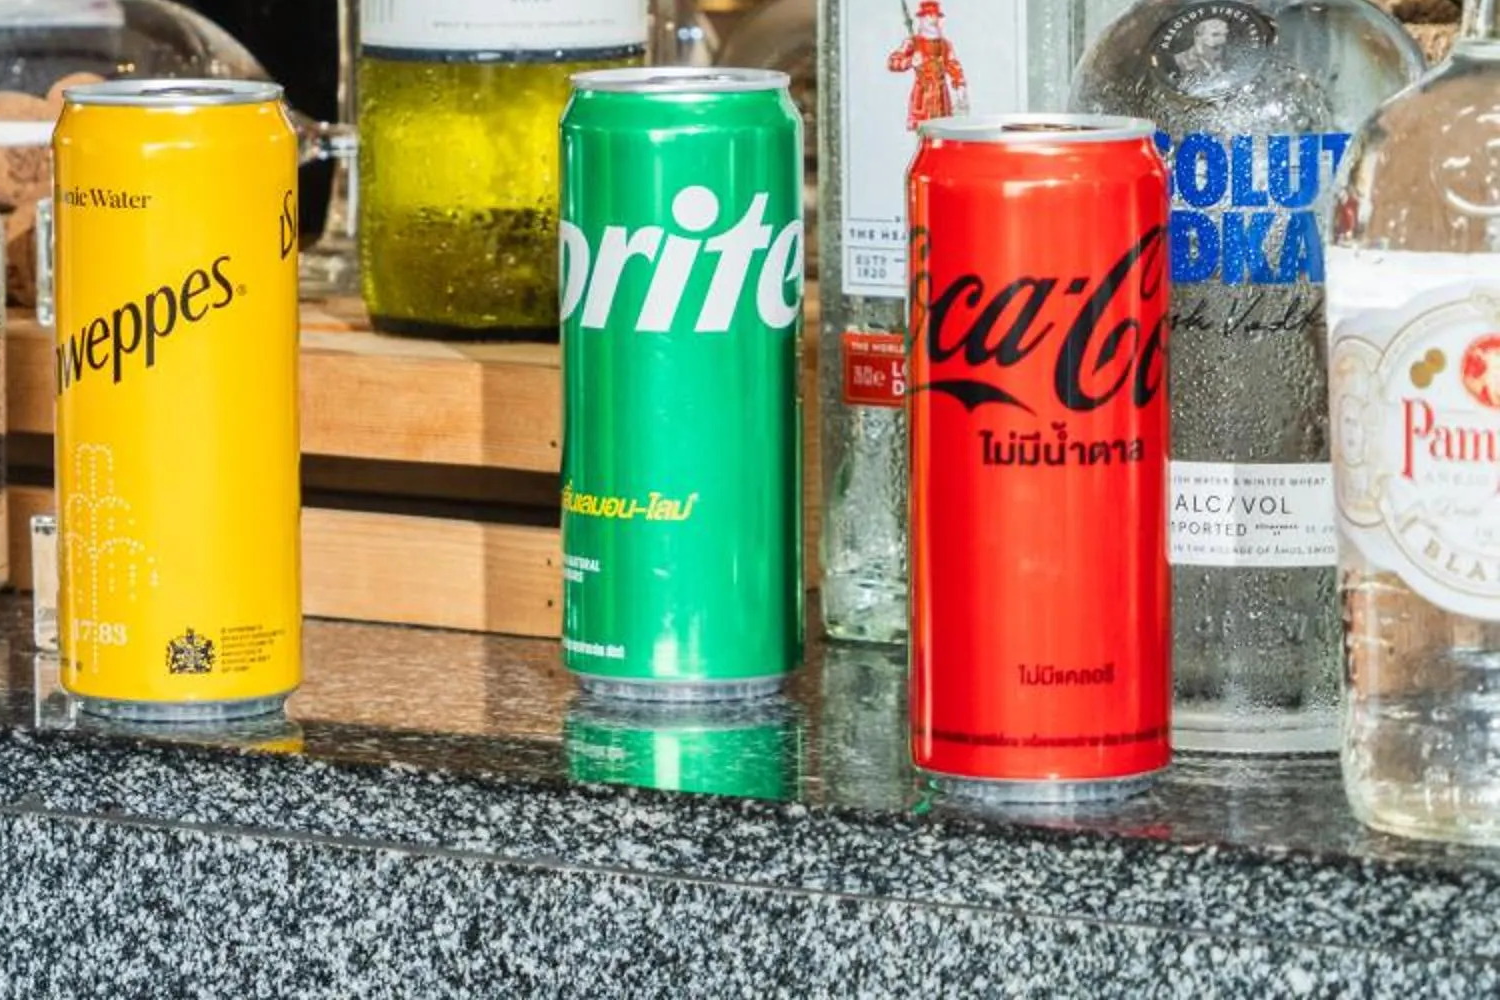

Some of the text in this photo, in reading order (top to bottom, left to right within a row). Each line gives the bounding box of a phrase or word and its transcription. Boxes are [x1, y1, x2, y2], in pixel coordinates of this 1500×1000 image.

[90, 187, 151, 209] Water
[279, 189, 296, 260] S
[849, 227, 875, 240] THE
[979, 421, 1146, 467] ไม่มีน้ำตาล
[1243, 477, 1286, 486] WINTER
[73, 617, 128, 647] 1783
